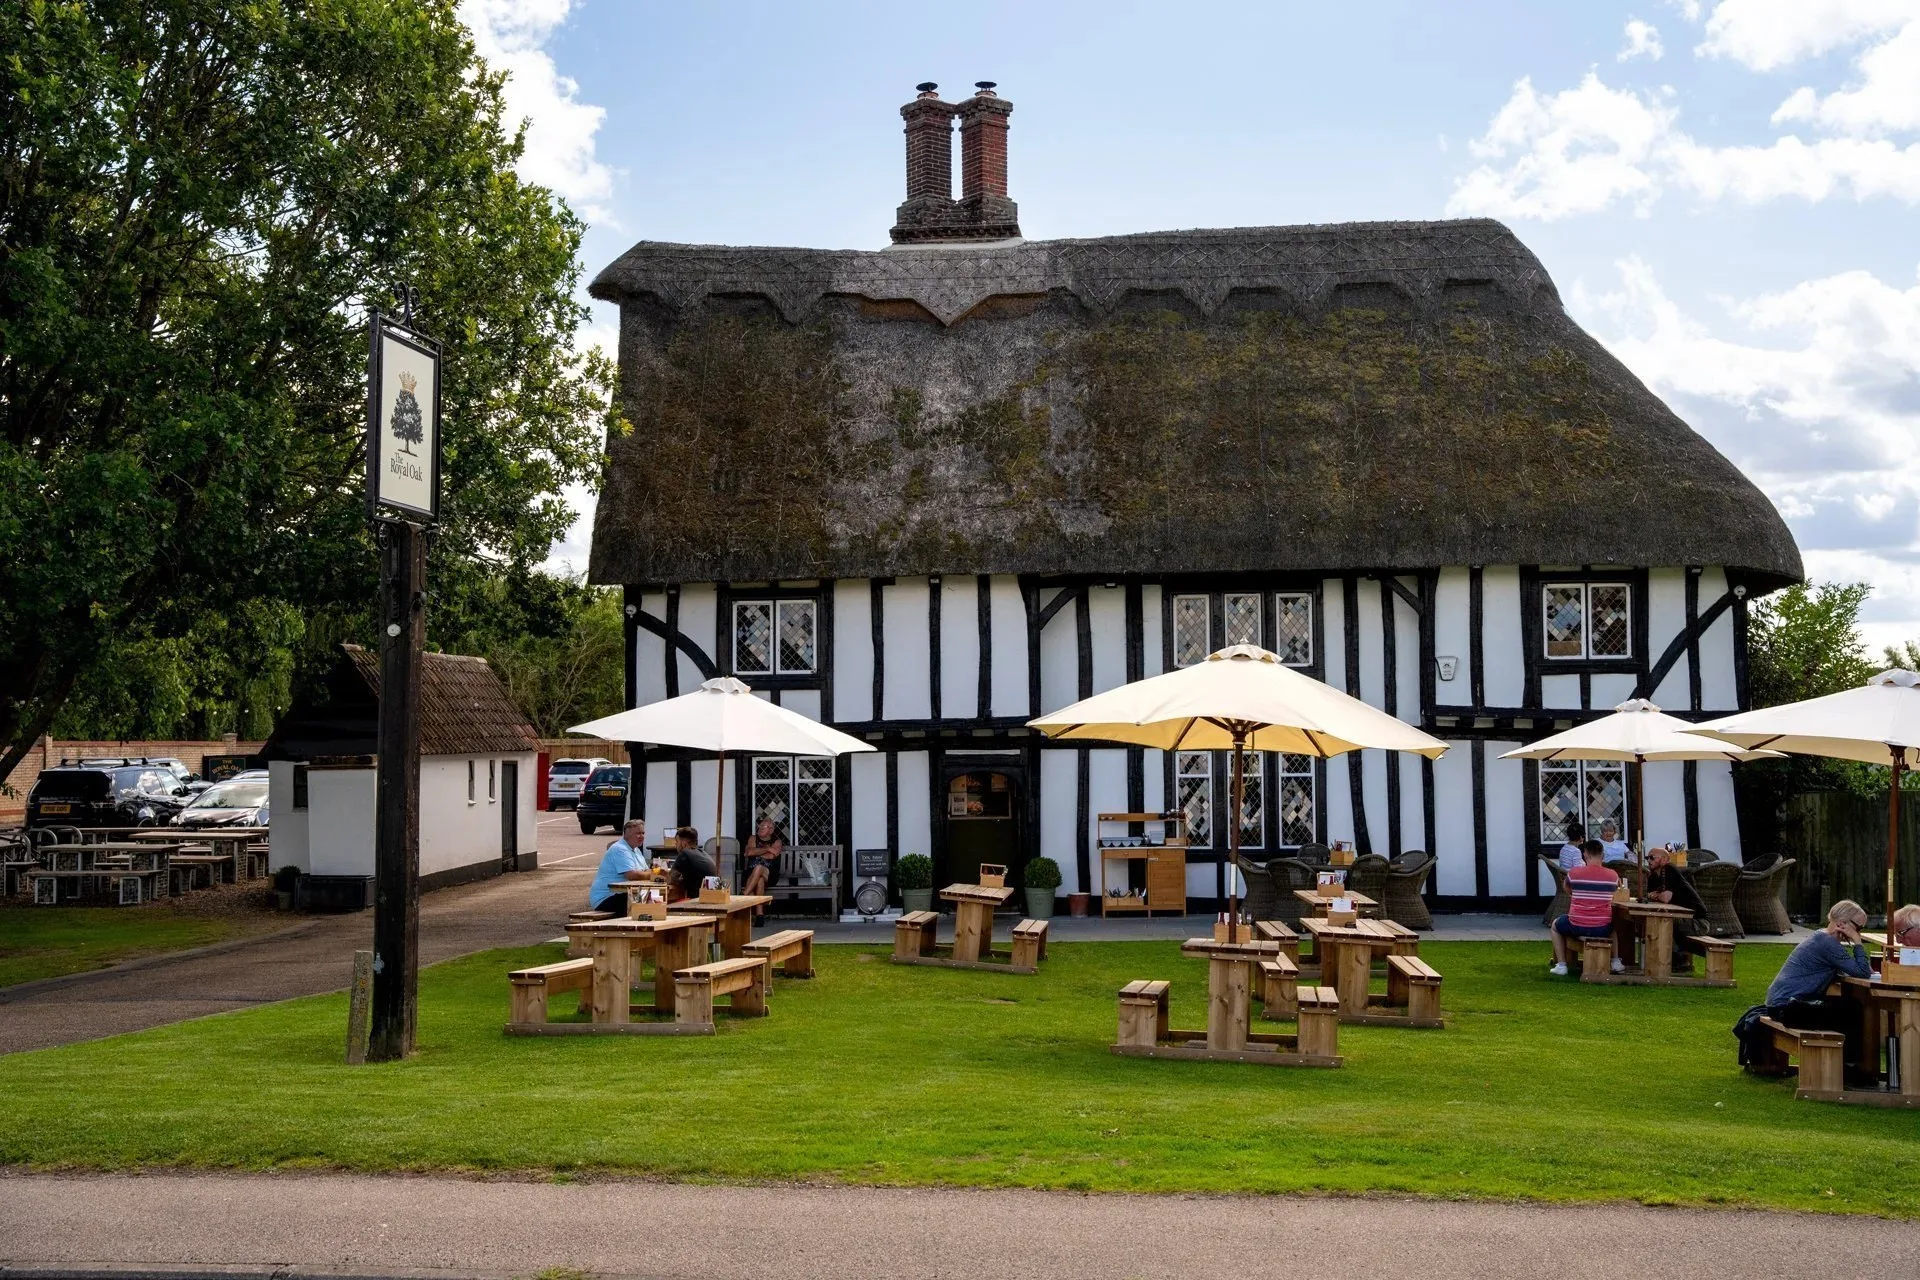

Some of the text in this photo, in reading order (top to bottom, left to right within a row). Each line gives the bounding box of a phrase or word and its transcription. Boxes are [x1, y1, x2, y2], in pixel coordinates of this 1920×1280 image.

[395, 452, 403, 464] The
[391, 458, 423, 481] Royal Oak
